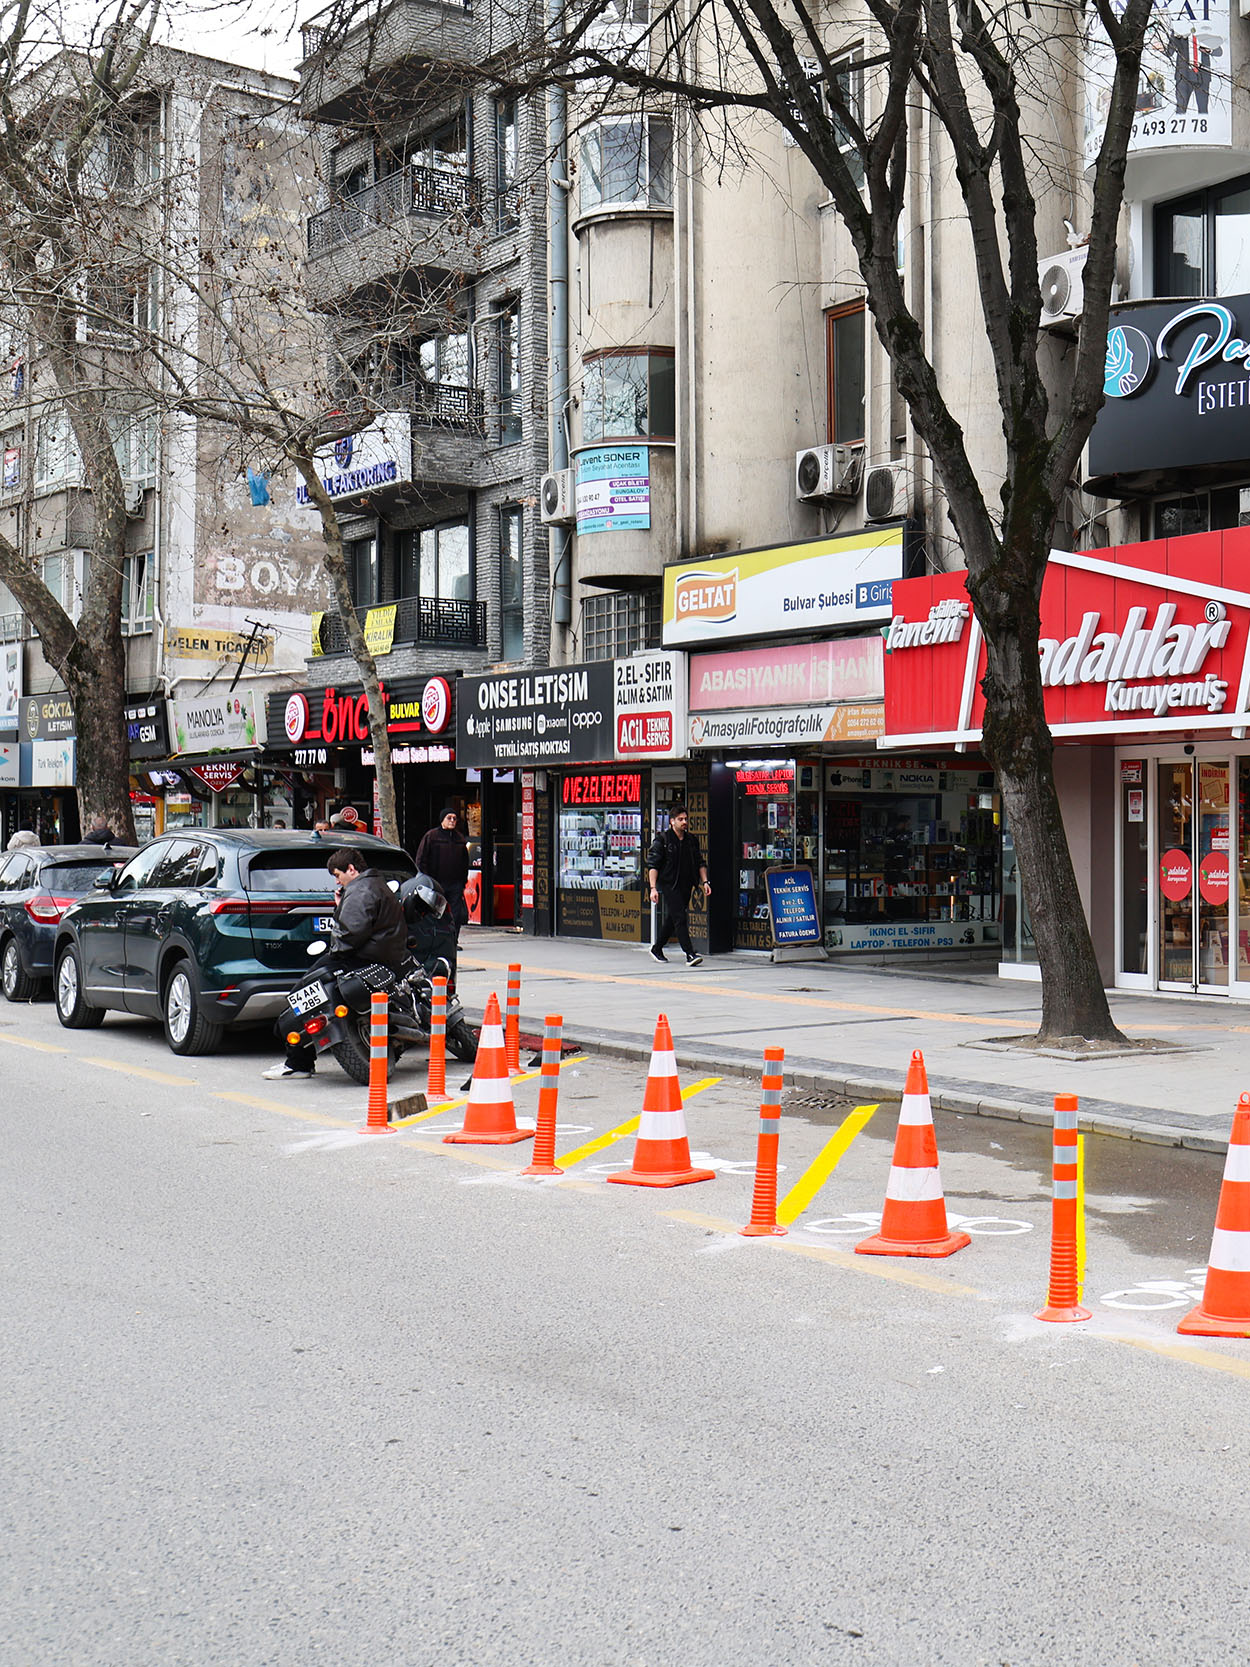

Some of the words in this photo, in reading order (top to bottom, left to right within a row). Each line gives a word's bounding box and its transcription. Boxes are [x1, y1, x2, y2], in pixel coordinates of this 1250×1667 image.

[1143, 121, 1166, 135] 493
[1171, 119, 1186, 133] 27
[1191, 119, 1208, 133] 78
[603, 451, 641, 463] SONER
[678, 583, 735, 612] GELTAT
[783, 597, 816, 612] Bulvar
[818, 589, 854, 610] Şubesi
[860, 587, 867, 602] B
[617, 665, 638, 686] 2.EL
[645, 661, 672, 683] SIFIR
[700, 664, 807, 694] ABASIYANIK
[478, 680, 518, 711] ONSE
[617, 688, 638, 706] ALIM
[646, 683, 673, 703] SATIM
[1104, 673, 1229, 716] Kuruyemiş
[42, 700, 74, 719] GÖKTA
[390, 702, 420, 719] BULVAR
[186, 708, 225, 729] MANOLYA
[475, 717, 491, 738] Apple
[495, 718, 532, 733] SAMSUNG
[573, 711, 602, 729] oppo
[139, 725, 157, 743] GSM
[620, 719, 646, 748] ACİL
[647, 718, 670, 732] TEKNİK
[647, 731, 670, 747] SERVİS
[295, 750, 307, 764] 277
[308, 749, 316, 764] 77
[494, 741, 520, 757] YETKİLİ
[520, 741, 538, 758] SATIŞ
[539, 740, 571, 755] NOKTASI
[204, 771, 233, 780] SERVİS
[900, 774, 934, 783] NOKIA
[571, 776, 583, 803] VE
[601, 774, 641, 803] TELEFON
[689, 816, 707, 831] SIFIR
[784, 876, 796, 885] ACİL
[773, 886, 793, 895] TEKNİK
[793, 884, 810, 893] SERVİS
[783, 906, 806, 915] TELEFON
[320, 918, 334, 931] 54
[776, 916, 793, 924] ALINIR
[796, 914, 816, 923] SATILIR
[778, 929, 797, 939] FATURA
[798, 928, 816, 937] ÖDEME
[898, 928, 908, 936] EL
[736, 935, 757, 948] ALIM
[850, 939, 885, 949] LAPTOP
[892, 938, 930, 948] TELEFON
[937, 937, 953, 946] PS3
[289, 994, 303, 1006] 54
[303, 981, 321, 999] AAY
[302, 995, 322, 1011] 285
